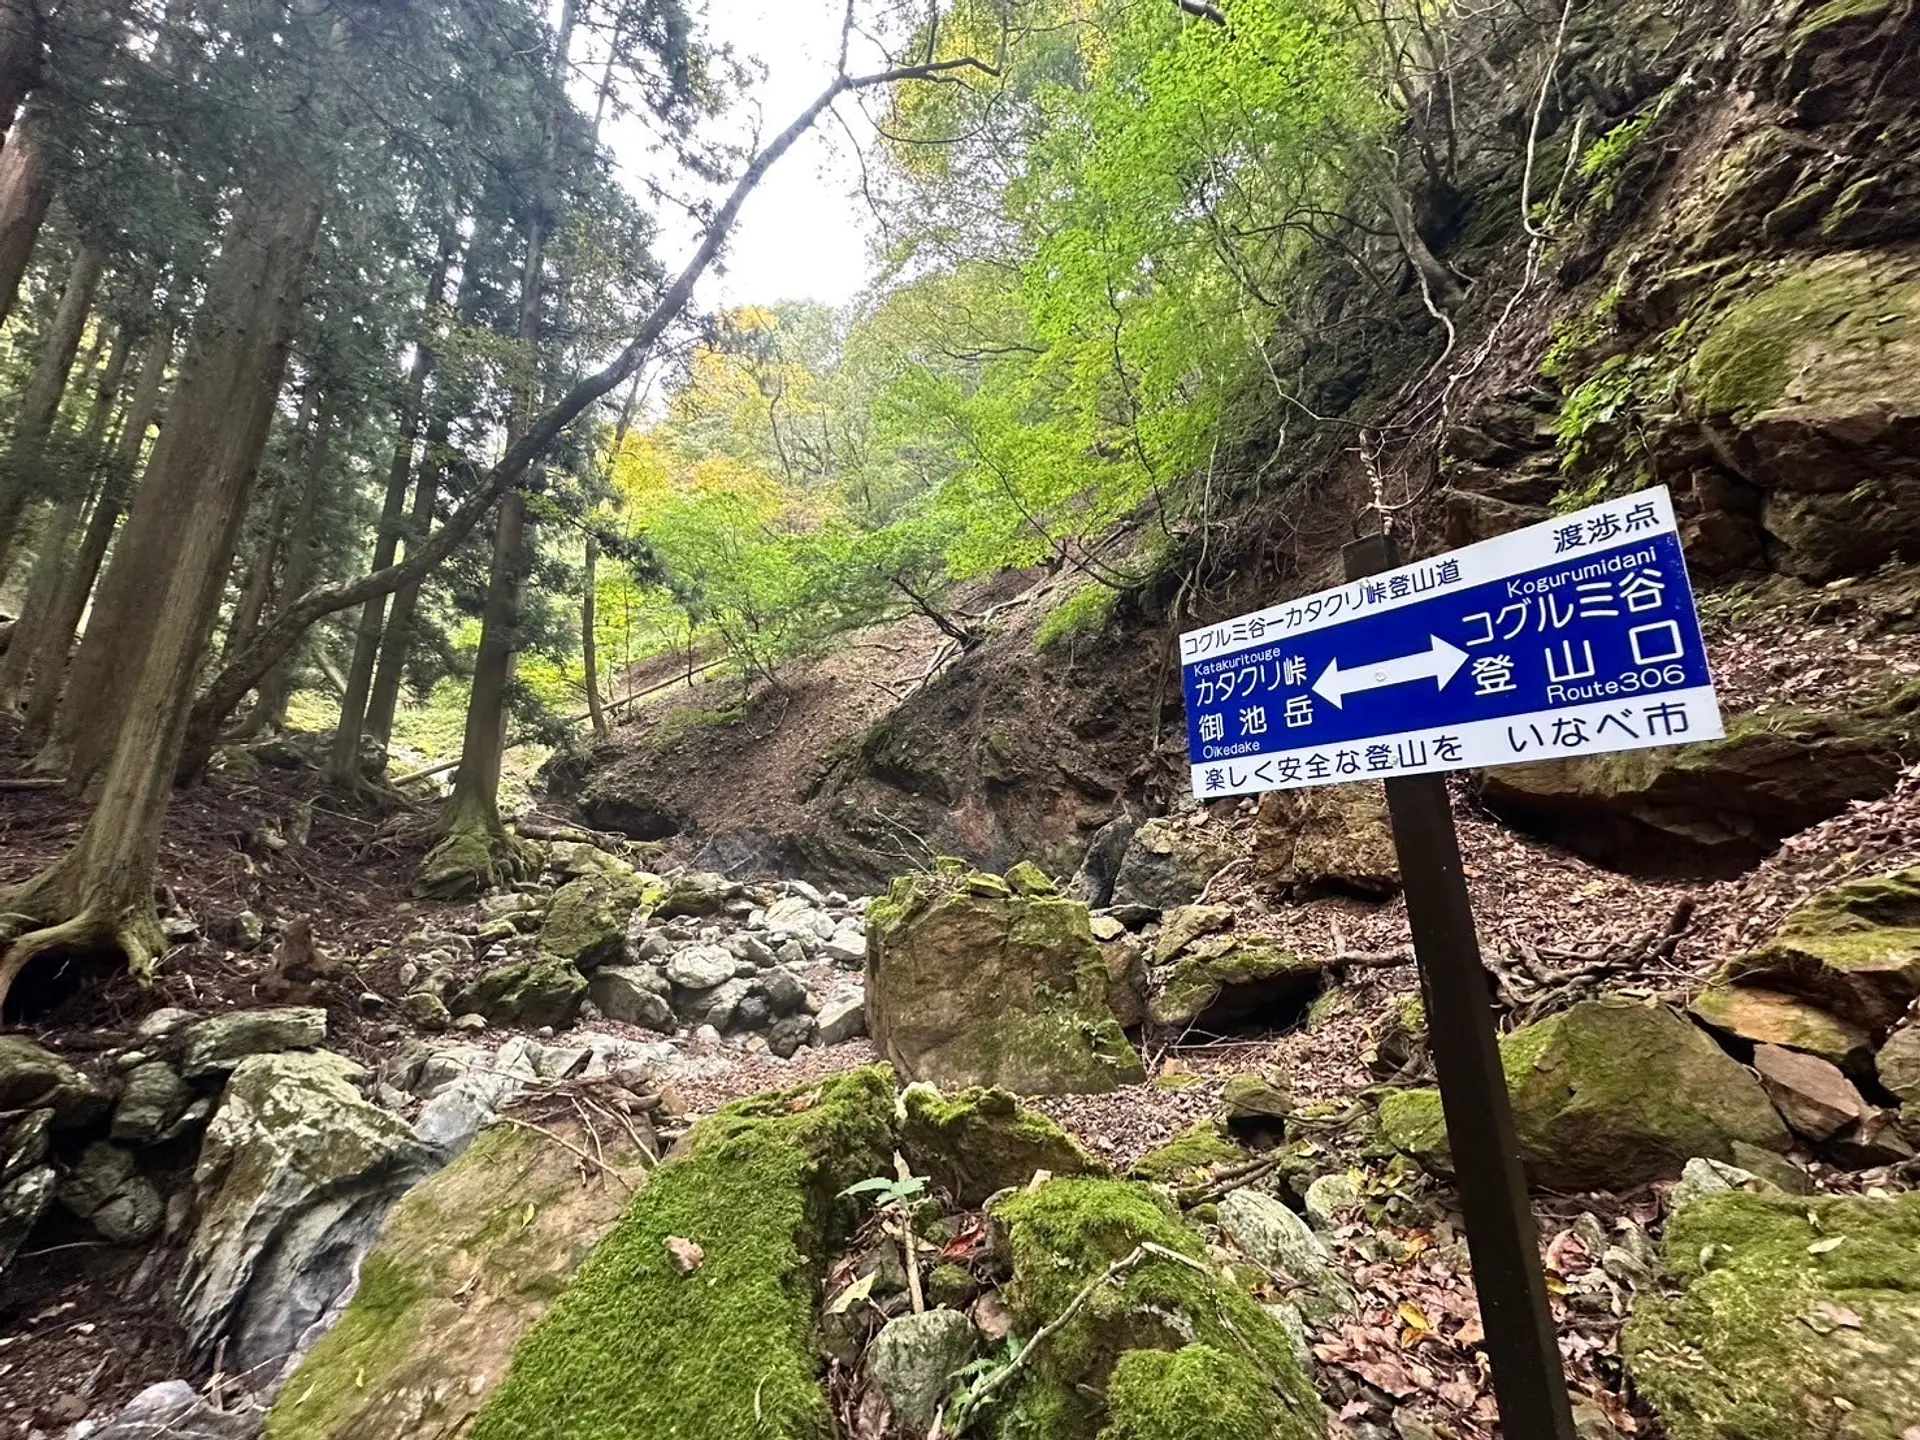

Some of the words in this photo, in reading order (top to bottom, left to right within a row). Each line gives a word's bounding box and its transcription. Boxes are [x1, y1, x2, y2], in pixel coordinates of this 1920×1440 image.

[1553, 501, 1660, 554] 渡渉点
[1507, 546, 1657, 598] Kogurumidani
[1462, 568, 1665, 646] コグルミ谷
[1194, 646, 1281, 677] Katakuritouge
[1195, 656, 1308, 706] カタクリ峠
[1471, 619, 1685, 696] 登山口
[1547, 664, 1686, 704] Route306
[1199, 695, 1313, 742] 御池岳
[1508, 702, 1689, 752] いなべ市
[1203, 740, 1260, 759] Oikedake
[1205, 735, 1463, 791] 楽しく安全な登山を
